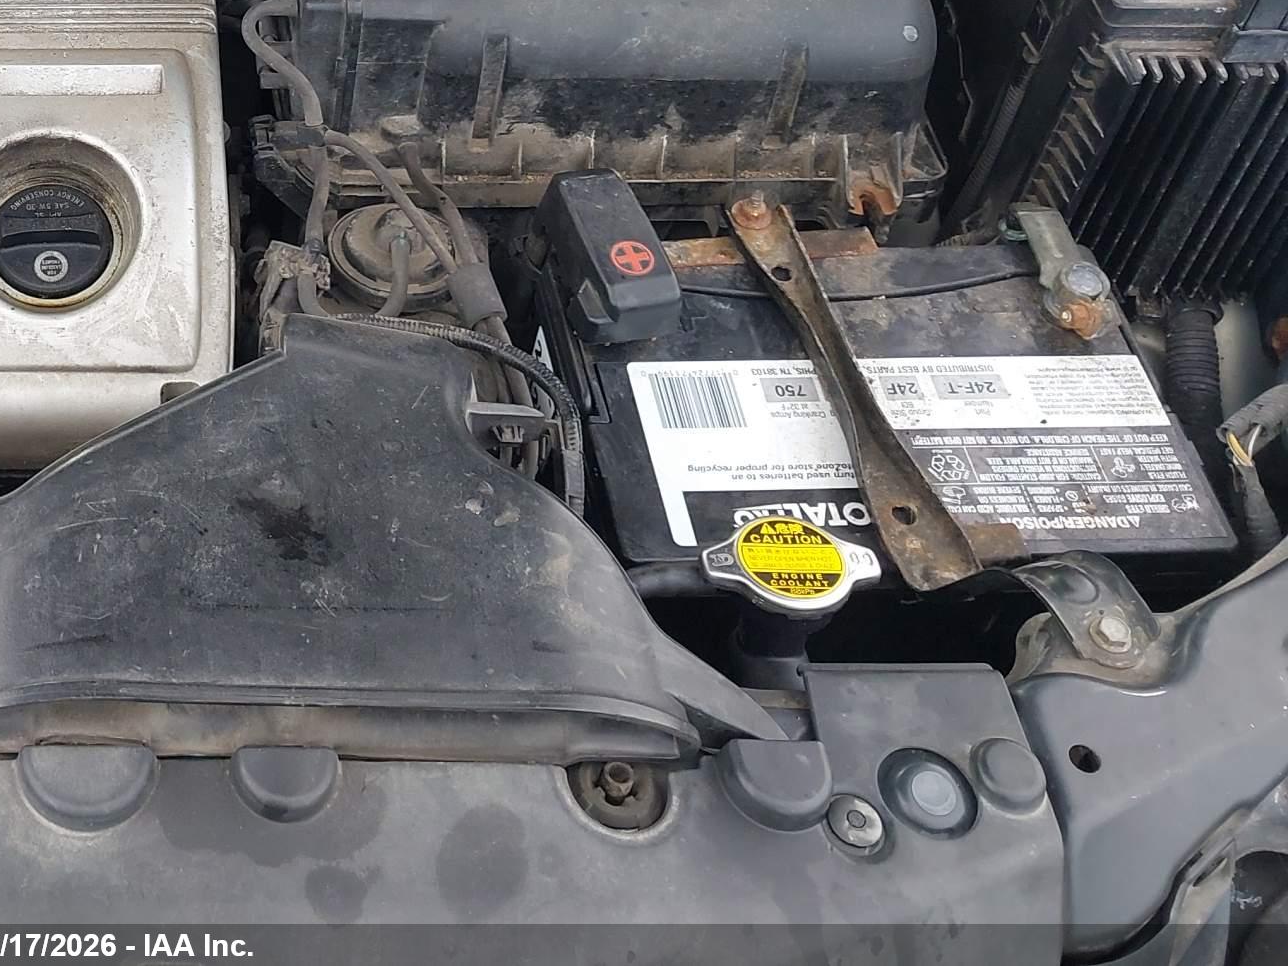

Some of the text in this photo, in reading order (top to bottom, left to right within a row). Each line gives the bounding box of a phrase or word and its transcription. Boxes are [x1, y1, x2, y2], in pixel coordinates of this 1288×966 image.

[10, 189, 85, 211] ENERGY CONSERVING
[751, 368, 777, 376] 38103
[898, 365, 920, 374] BEST
[922, 365, 934, 373] BY
[936, 365, 995, 373] DISTRIBUTED
[775, 384, 807, 397] 750
[886, 382, 918, 395] 24F
[948, 381, 996, 394] 24F-T
[687, 463, 732, 473] recycling
[735, 462, 768, 471] proper
[772, 464, 785, 472] for
[787, 463, 813, 471] store
[746, 473, 756, 481] to
[759, 472, 804, 482] batteries
[807, 472, 831, 482] used
[833, 472, 856, 480] turn
[749, 534, 823, 544] CAUTION
[772, 572, 824, 580] ENGINE
